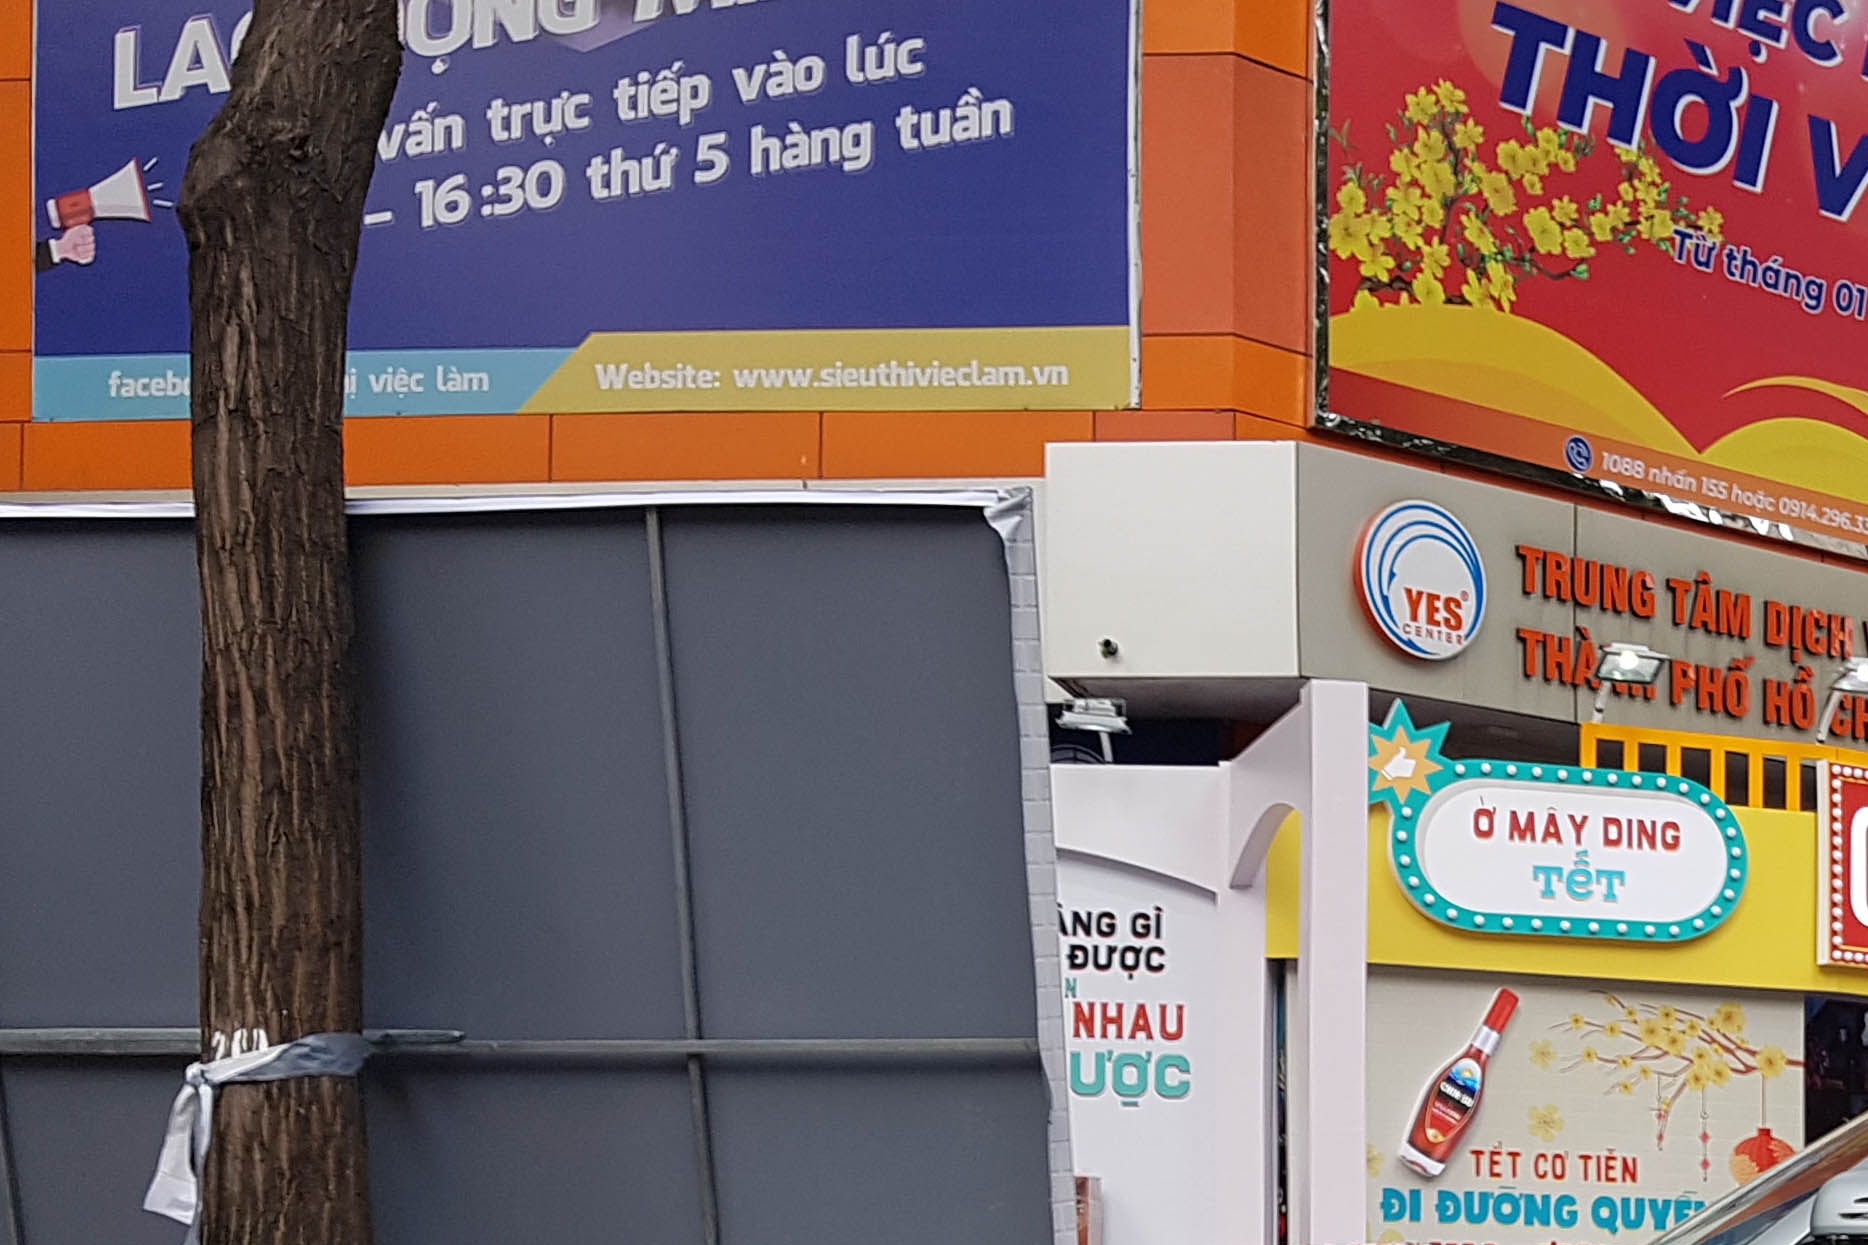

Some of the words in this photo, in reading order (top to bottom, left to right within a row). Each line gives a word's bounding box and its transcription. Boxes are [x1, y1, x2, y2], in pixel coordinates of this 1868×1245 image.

[114, 12, 252, 110] LA
[487, 90, 591, 147] trực
[613, 61, 712, 127] tiếp
[732, 50, 825, 102] vào
[846, 31, 925, 84] lúc
[1490, 1, 1780, 193] THỜI
[586, 143, 678, 199] thứ
[694, 133, 728, 184] 5
[751, 122, 873, 175] hàng
[897, 87, 1014, 151] tuần
[1672, 227, 1719, 272] Từ
[1722, 245, 1827, 313] tháng
[1833, 280, 1868, 320] 01
[108, 371, 190, 398] faceb
[368, 370, 424, 399] việc
[436, 365, 490, 392] làm
[595, 361, 720, 391] Website:
[733, 359, 1068, 389] www.sieuthivieclam.vn
[1601, 452, 1645, 479] 1088
[1700, 476, 1728, 500] 155
[1404, 587, 1463, 631] YES
[1516, 544, 1656, 619] TRUNG
[1667, 570, 1751, 639] TÂM
[1765, 599, 1854, 663] DỊCH
[1403, 623, 1463, 645] CENTER
[1517, 626, 1656, 699] THÀ
[1668, 656, 1755, 719] PHỐ
[1764, 665, 1815, 730] HỒ
[1508, 806, 1589, 846] MÂY
[1602, 815, 1682, 852] DING
[1131, 906, 1163, 939] GÌ
[1066, 944, 1165, 980] ĐƯỢC
[1073, 1001, 1185, 1041] NHAU
[1470, 1140, 1521, 1178] TẾT
[1380, 1187, 1421, 1223] ĐI
[1435, 1185, 1578, 1229] ĐƯỜNG
